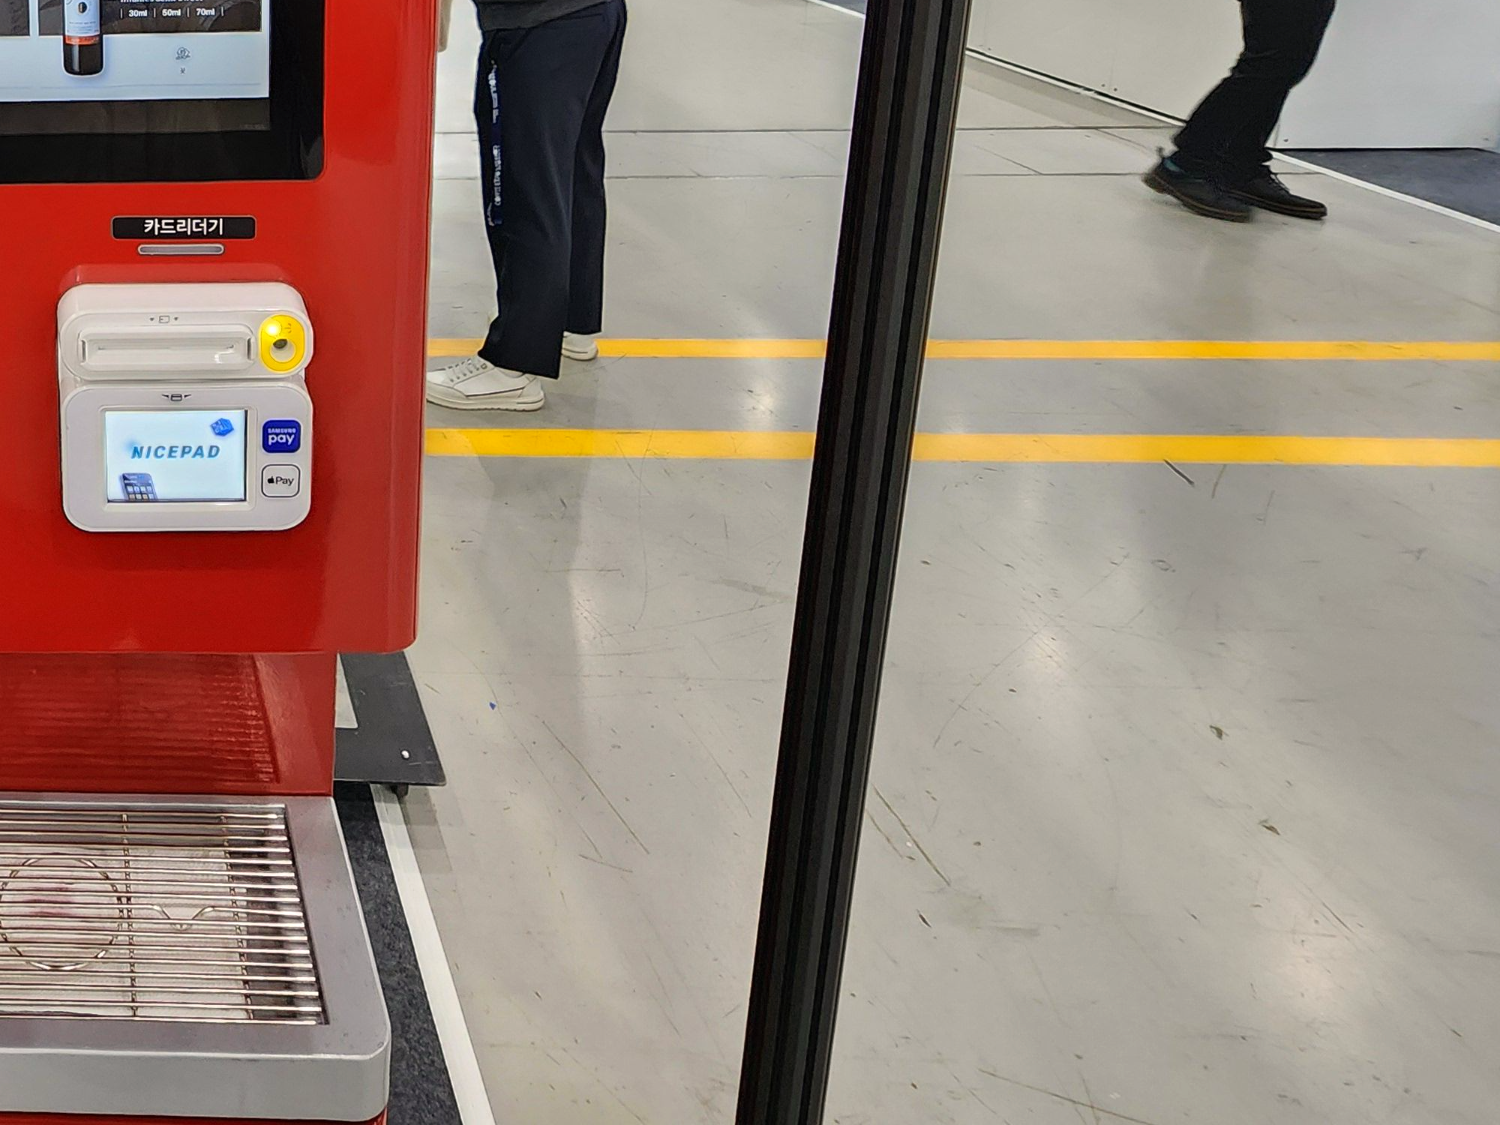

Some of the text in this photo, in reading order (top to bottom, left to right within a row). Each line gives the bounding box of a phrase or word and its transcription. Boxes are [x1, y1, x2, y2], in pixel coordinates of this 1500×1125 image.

[128, 9, 148, 18] 30ml
[196, 8, 216, 17] 70ml
[143, 217, 225, 236] 카드리더기
[268, 434, 295, 446] pay
[130, 444, 221, 459] NICEPAD
[275, 476, 295, 486] Pay
